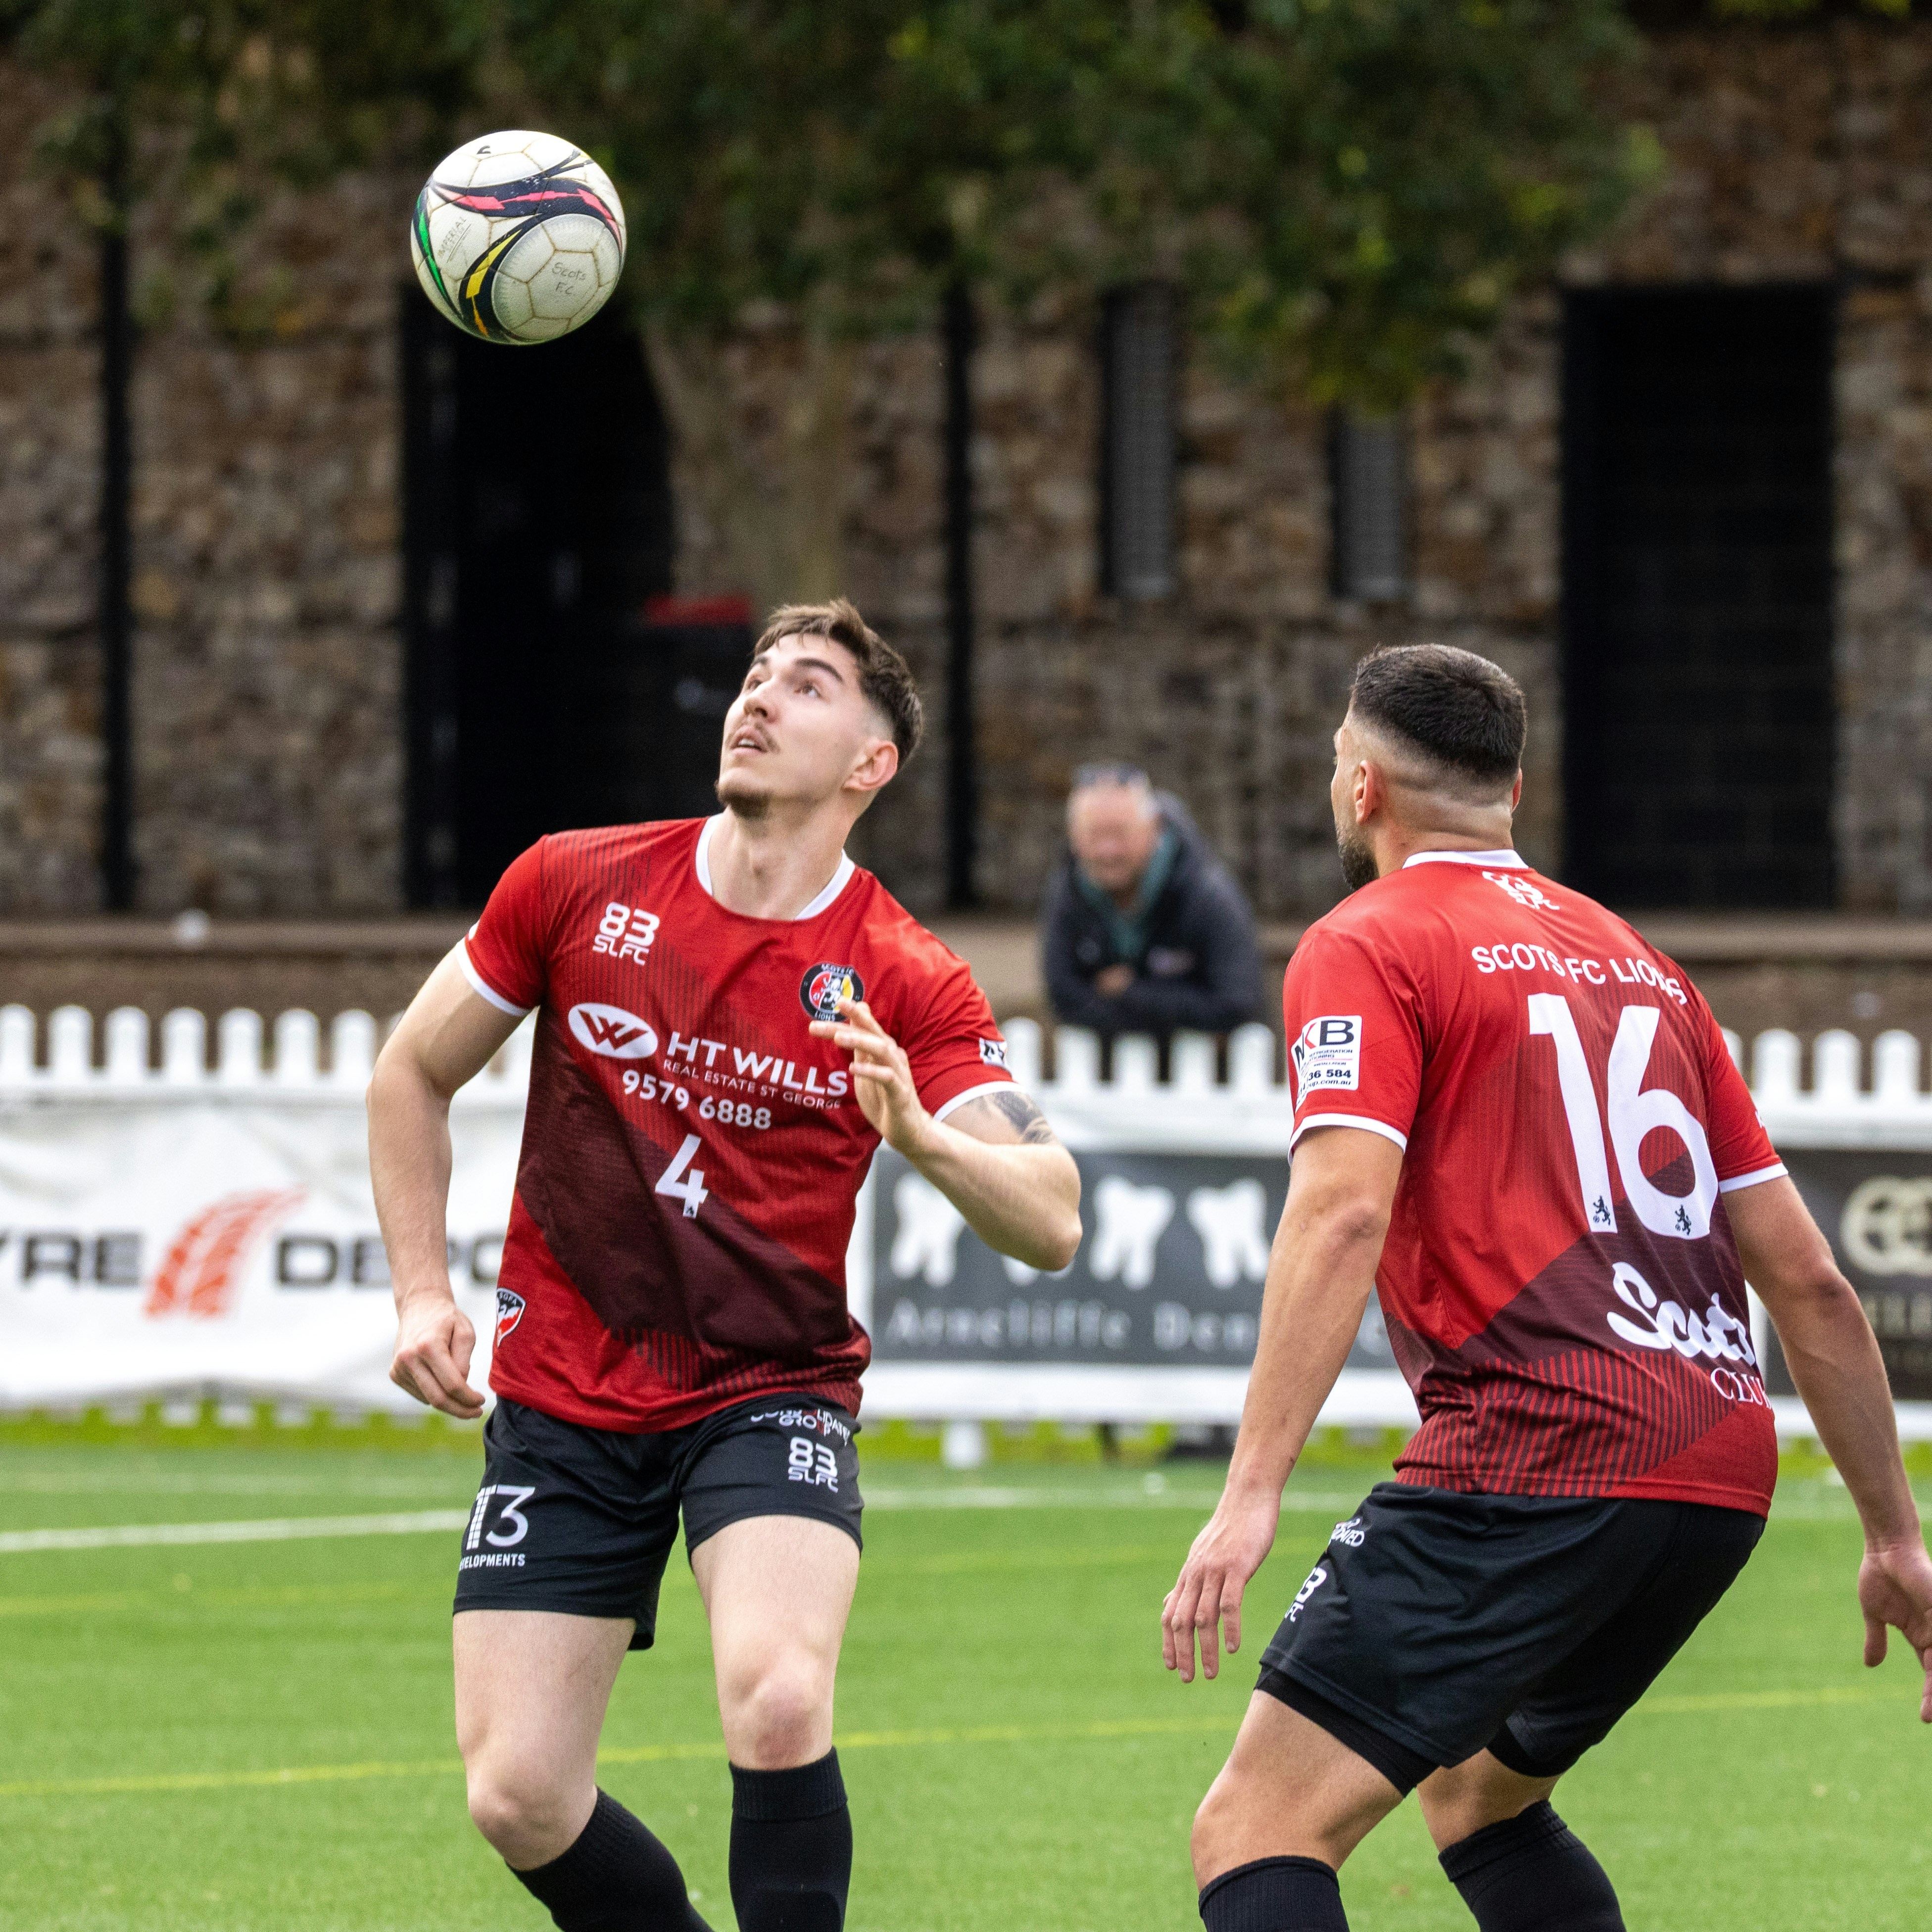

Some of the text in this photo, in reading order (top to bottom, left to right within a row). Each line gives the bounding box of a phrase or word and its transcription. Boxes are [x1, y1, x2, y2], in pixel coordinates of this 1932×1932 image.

[552, 262, 586, 281] Scots
[599, 902, 660, 947] 83
[592, 934, 649, 966] SLFC
[1471, 943, 1688, 1005] SCOTS FC LIONS
[664, 1059, 841, 1110] REAL ESTATE ST GEORGE
[667, 1031, 848, 1097] HT WILLS
[1326, 1069, 1352, 1078] 584
[623, 1069, 772, 1130] 9579 6888
[1528, 993, 1718, 1239] 16
[655, 1133, 709, 1218] 4
[788, 1436, 838, 1478] 83
[788, 1466, 839, 1493] SLFC
[466, 1484, 536, 1550] 13
[1295, 1567, 1327, 1603] 3
